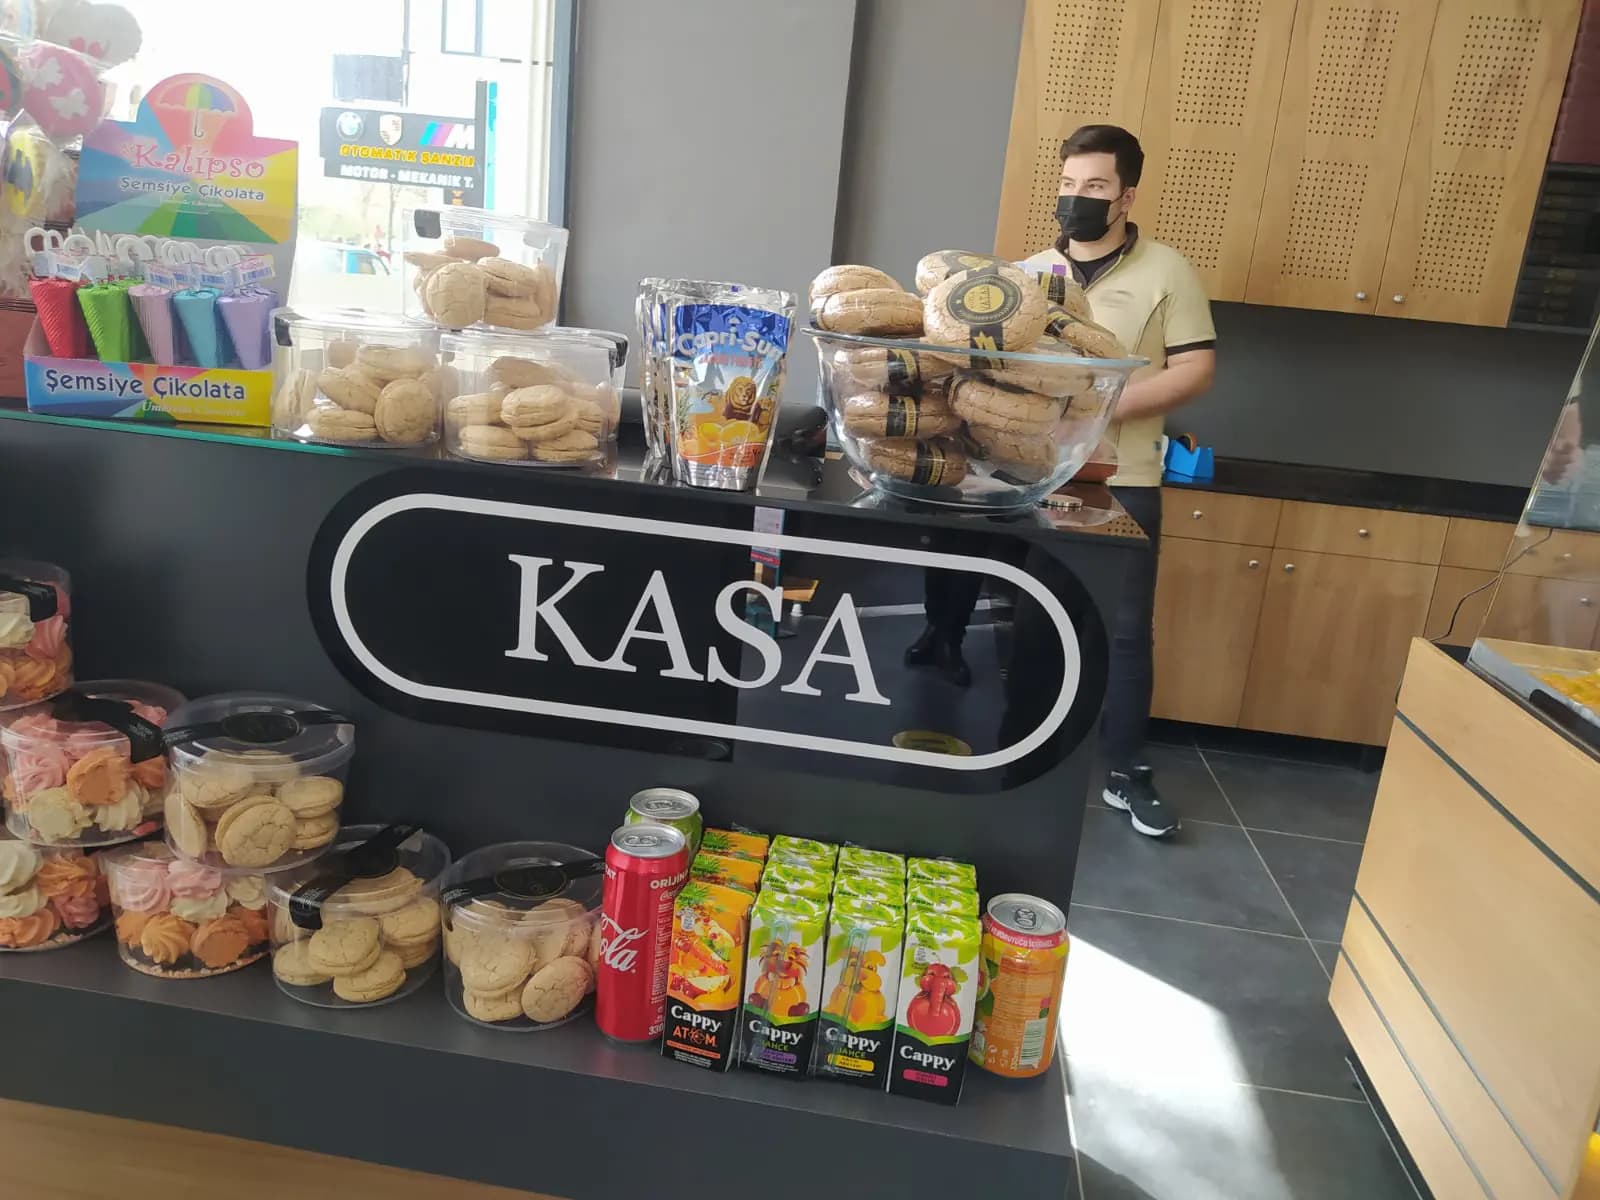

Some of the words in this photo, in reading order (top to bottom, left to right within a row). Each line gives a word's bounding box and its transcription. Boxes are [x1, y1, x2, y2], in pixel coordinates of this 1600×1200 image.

[132, 143, 265, 180] Kalipso
[340, 164, 388, 180] MOTOR
[46, 369, 143, 397] Şemsiye
[153, 376, 246, 401] Çikolata
[505, 553, 891, 706] KASA
[671, 1005, 721, 1033] Cappy
[749, 1020, 803, 1045] Cappy
[825, 1027, 880, 1053] Cappy
[900, 1045, 956, 1071] Cappy
